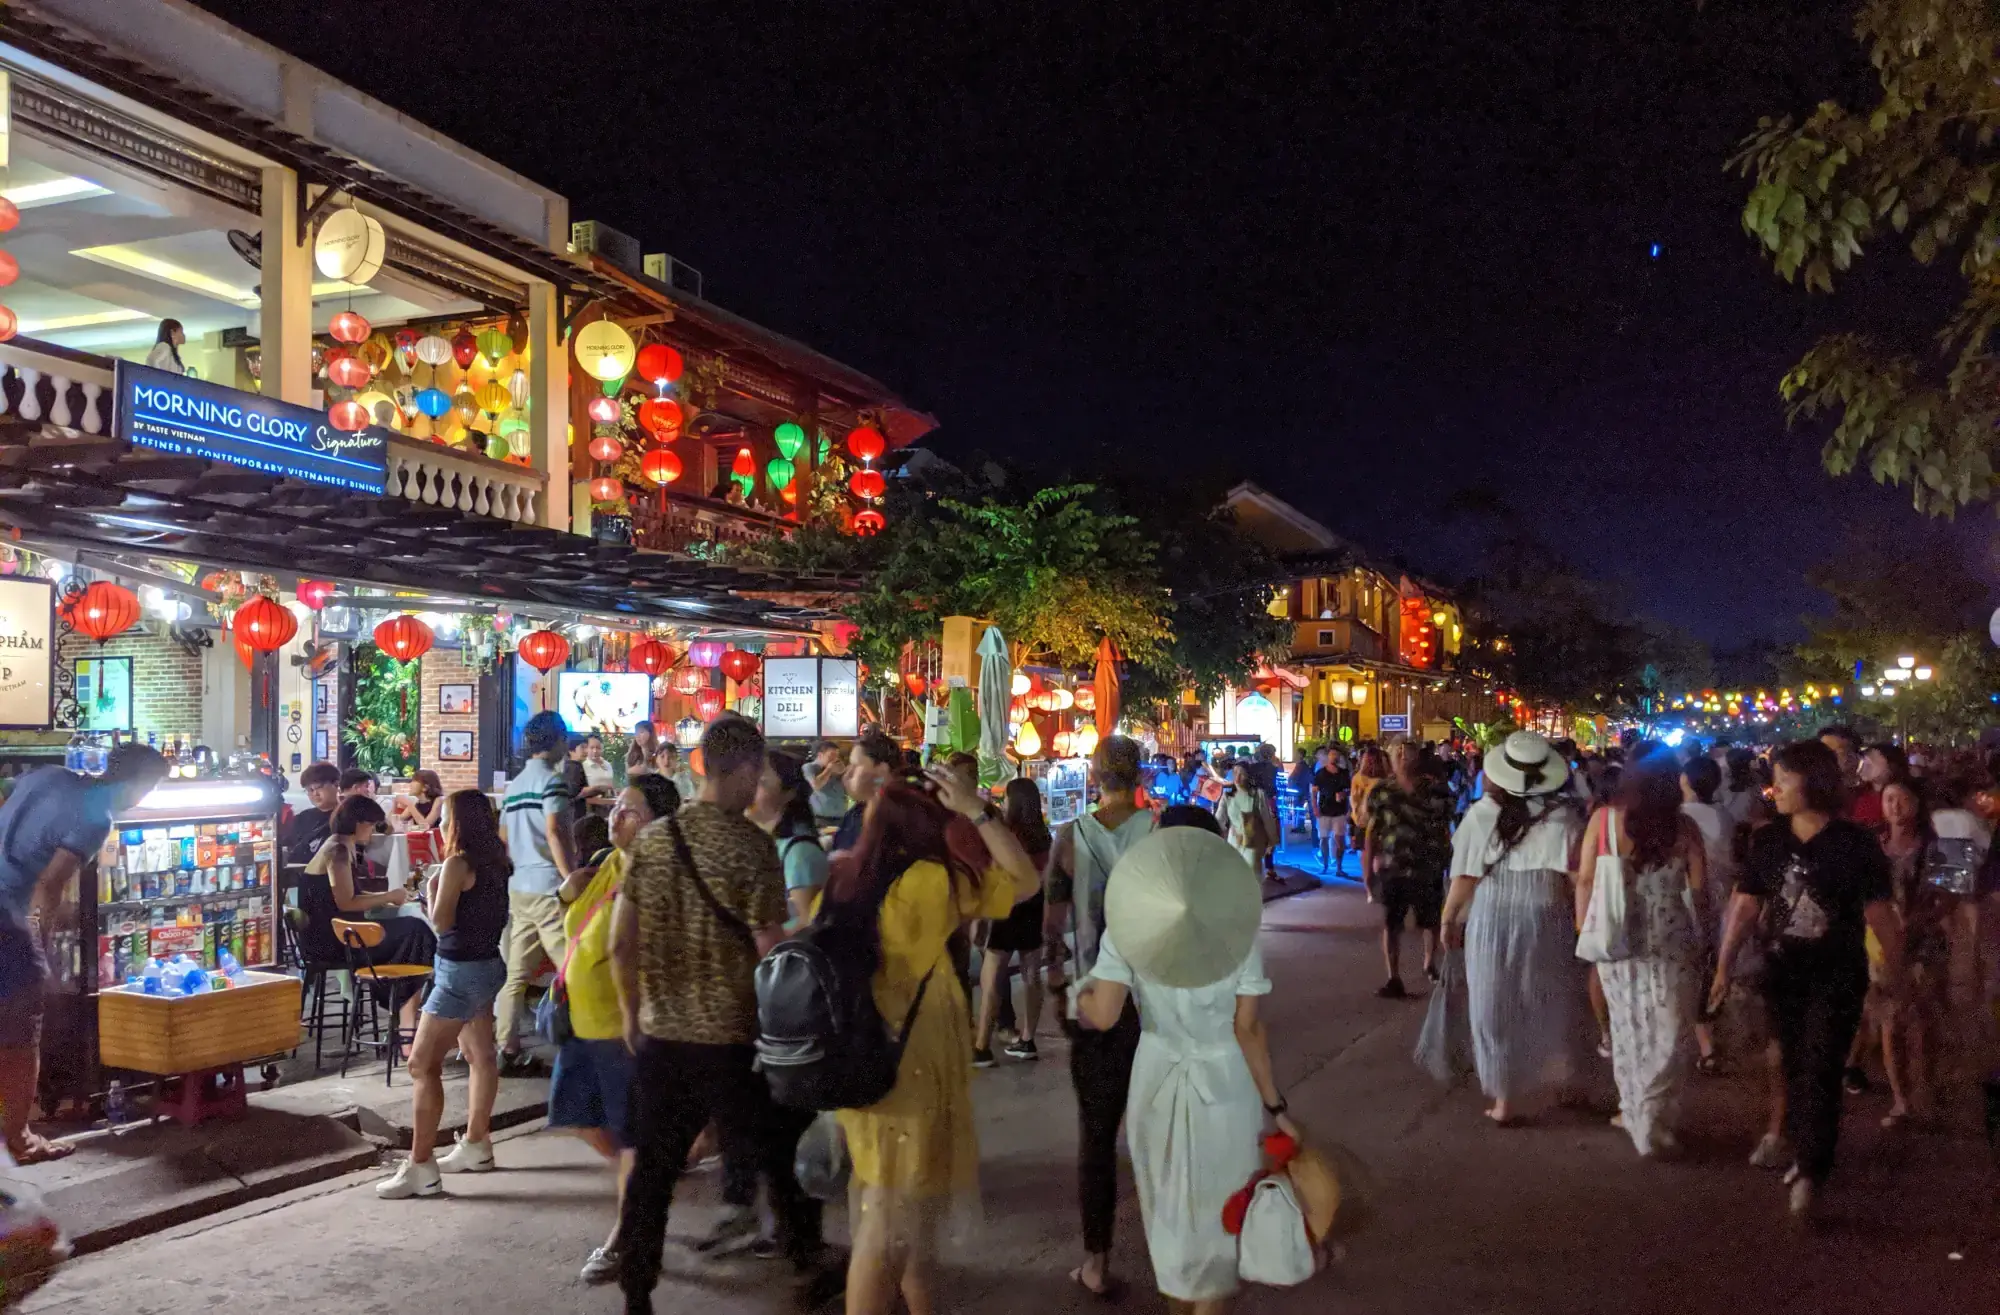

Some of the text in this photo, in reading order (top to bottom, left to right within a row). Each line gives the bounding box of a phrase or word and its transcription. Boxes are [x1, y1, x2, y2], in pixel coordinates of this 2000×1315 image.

[134, 384, 382, 457] MORNING GLORY Signature
[133, 421, 206, 443] BY TASTE VIETNAM
[197, 448, 284, 474] CONTEMPORARY
[287, 467, 347, 487] VIETNAMESE
[349, 480, 382, 494] DINING
[767, 686, 814, 695] KITCHEN
[777, 702, 804, 712] DELI
